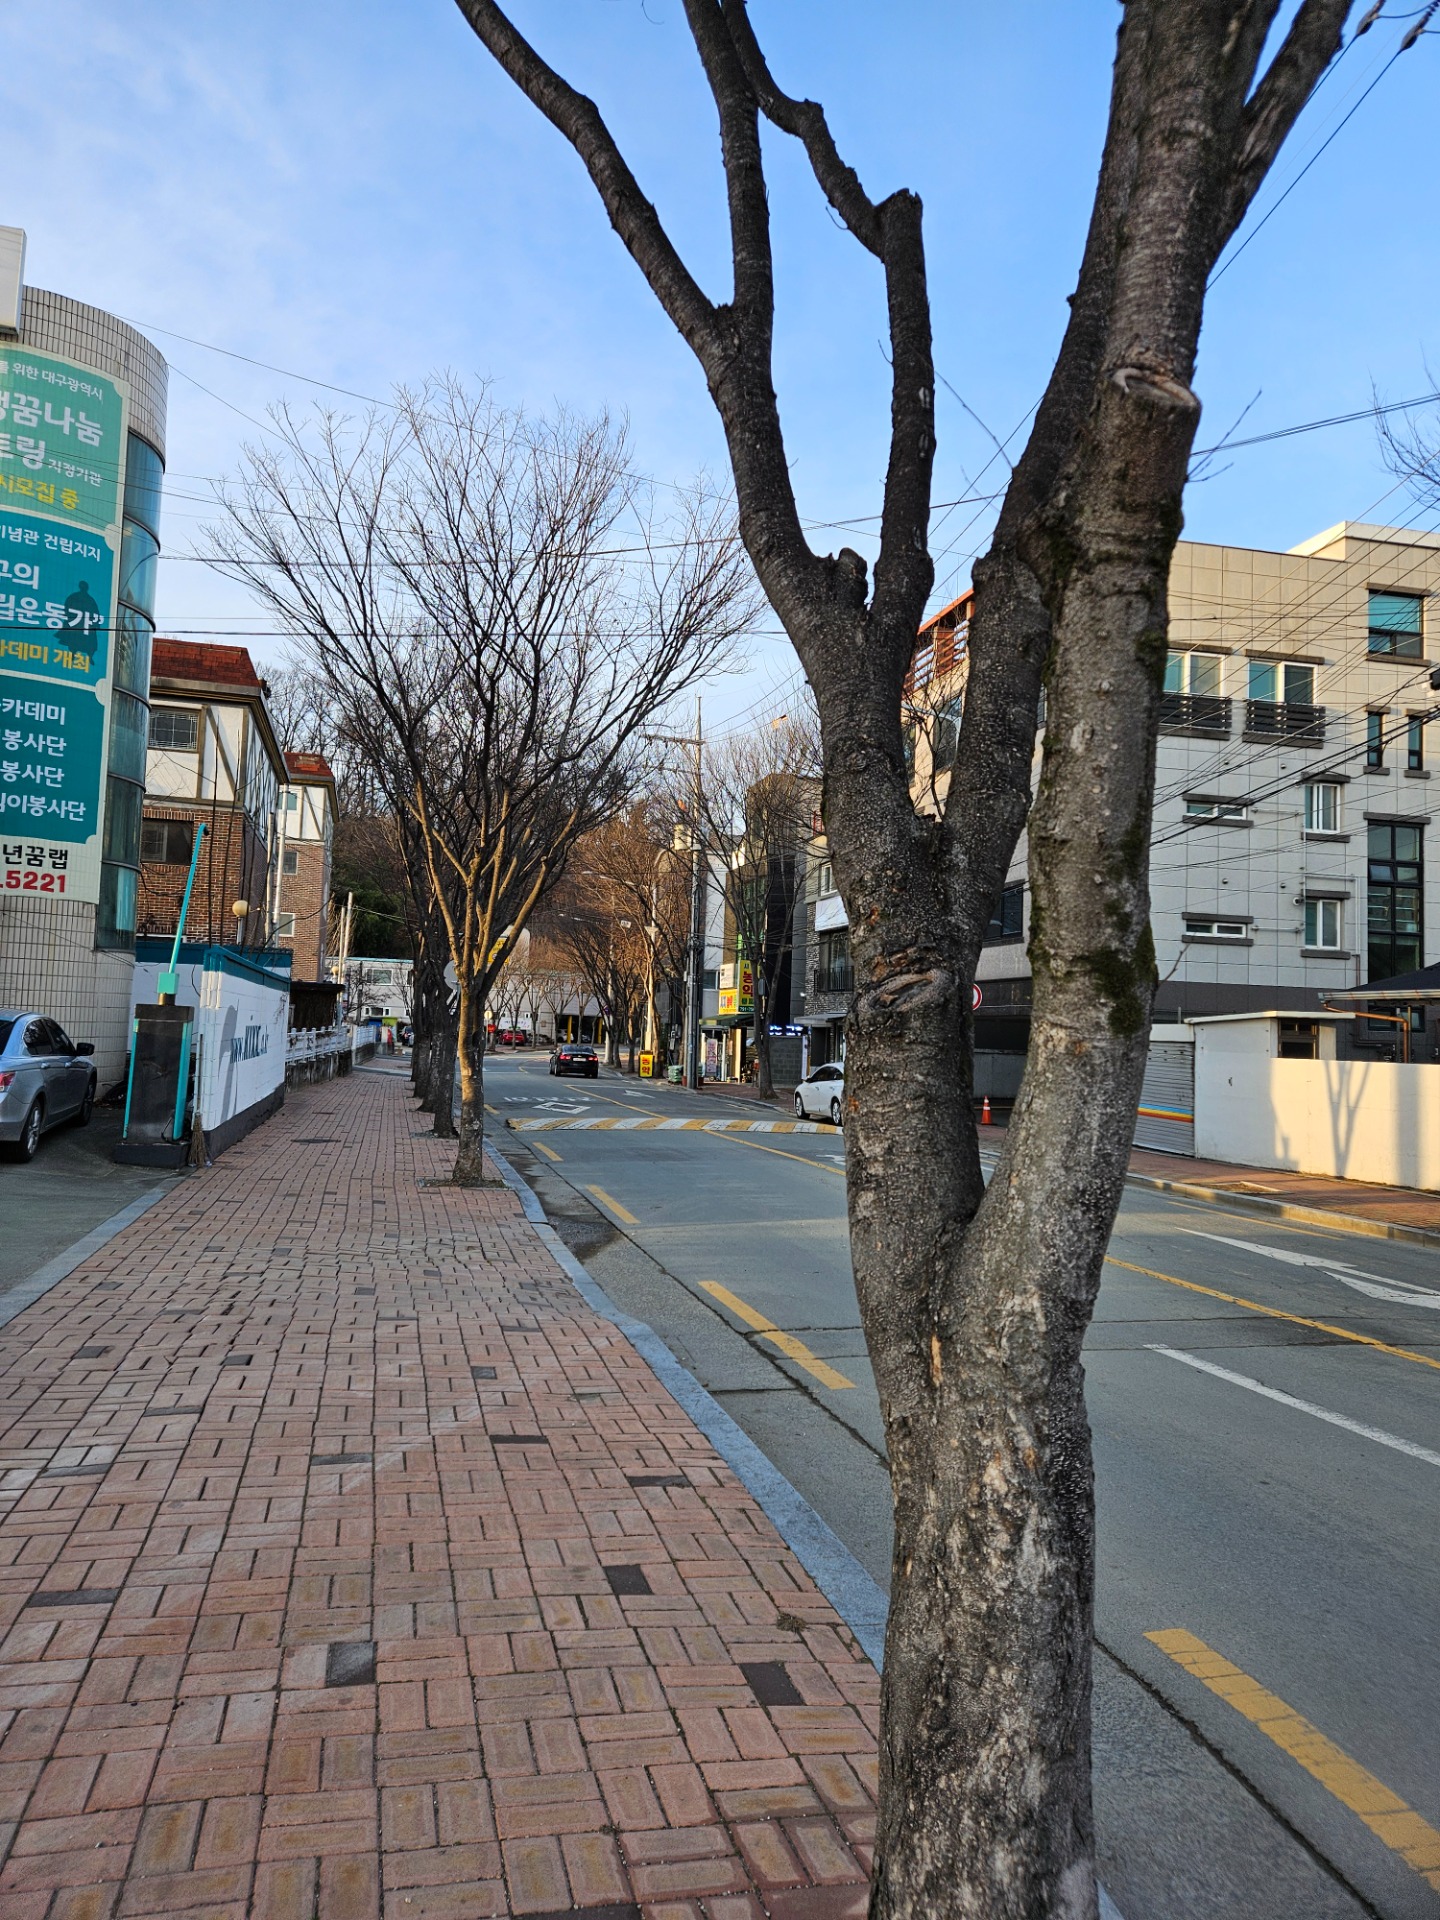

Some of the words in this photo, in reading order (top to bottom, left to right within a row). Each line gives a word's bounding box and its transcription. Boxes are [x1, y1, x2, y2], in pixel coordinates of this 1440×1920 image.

[12, 362, 39, 380] 위한
[42, 370, 103, 400] 대구광역시
[48, 458, 103, 487] 지정기관
[61, 487, 80, 510] 중
[44, 533, 101, 562] 건립지지
[53, 648, 90, 673] 개최
[2, 729, 67, 757] 봉사단
[0, 760, 65, 788] 봉사단
[2, 843, 69, 870] 년꿈랩
